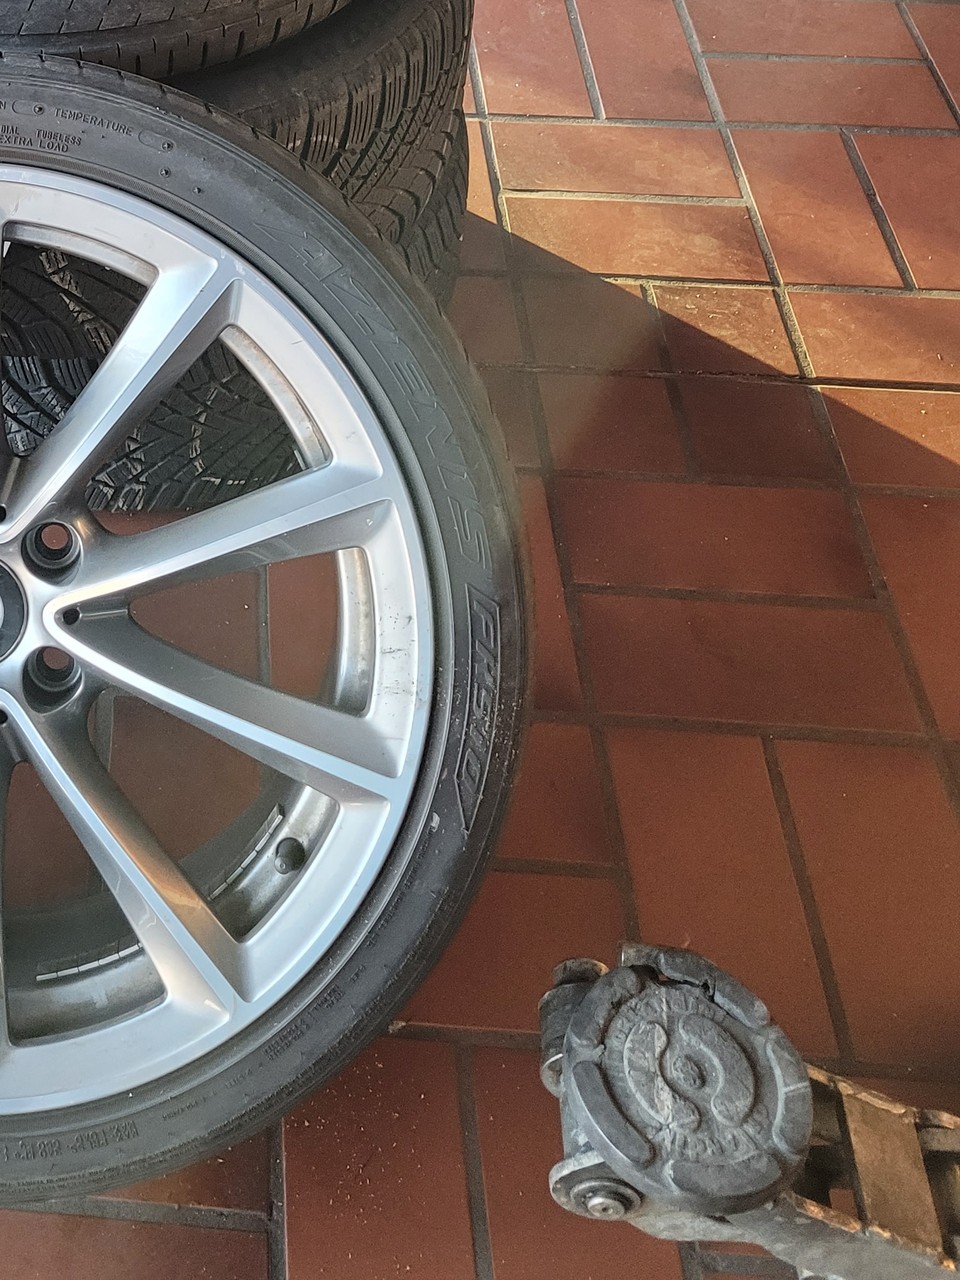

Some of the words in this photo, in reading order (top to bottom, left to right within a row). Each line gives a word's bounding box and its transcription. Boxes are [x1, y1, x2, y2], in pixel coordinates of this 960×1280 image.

[54, 107, 134, 137] TEMPERATURE
[35, 128, 83, 146] TUBELESS
[37, 139, 70, 154] LOAD
